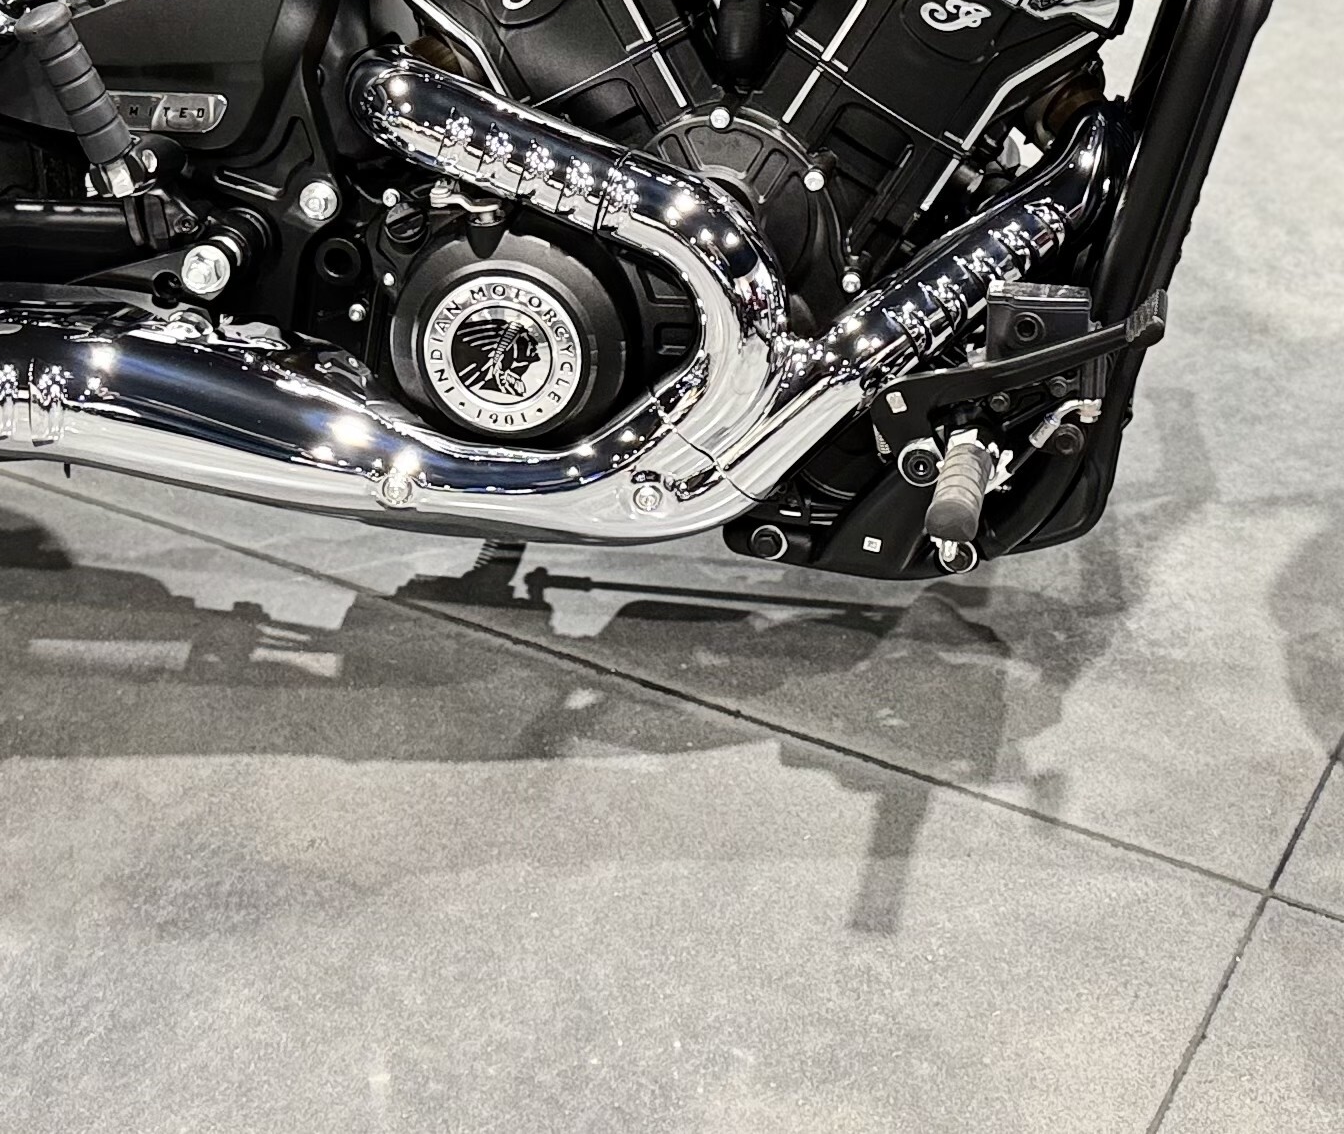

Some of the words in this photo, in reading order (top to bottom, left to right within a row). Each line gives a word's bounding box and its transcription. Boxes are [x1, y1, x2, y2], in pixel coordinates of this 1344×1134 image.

[116, 105, 205, 119] MITED
[430, 299, 463, 395] INDIAN
[469, 284, 575, 404] MOTORCYCLE
[476, 408, 529, 426] 1901
